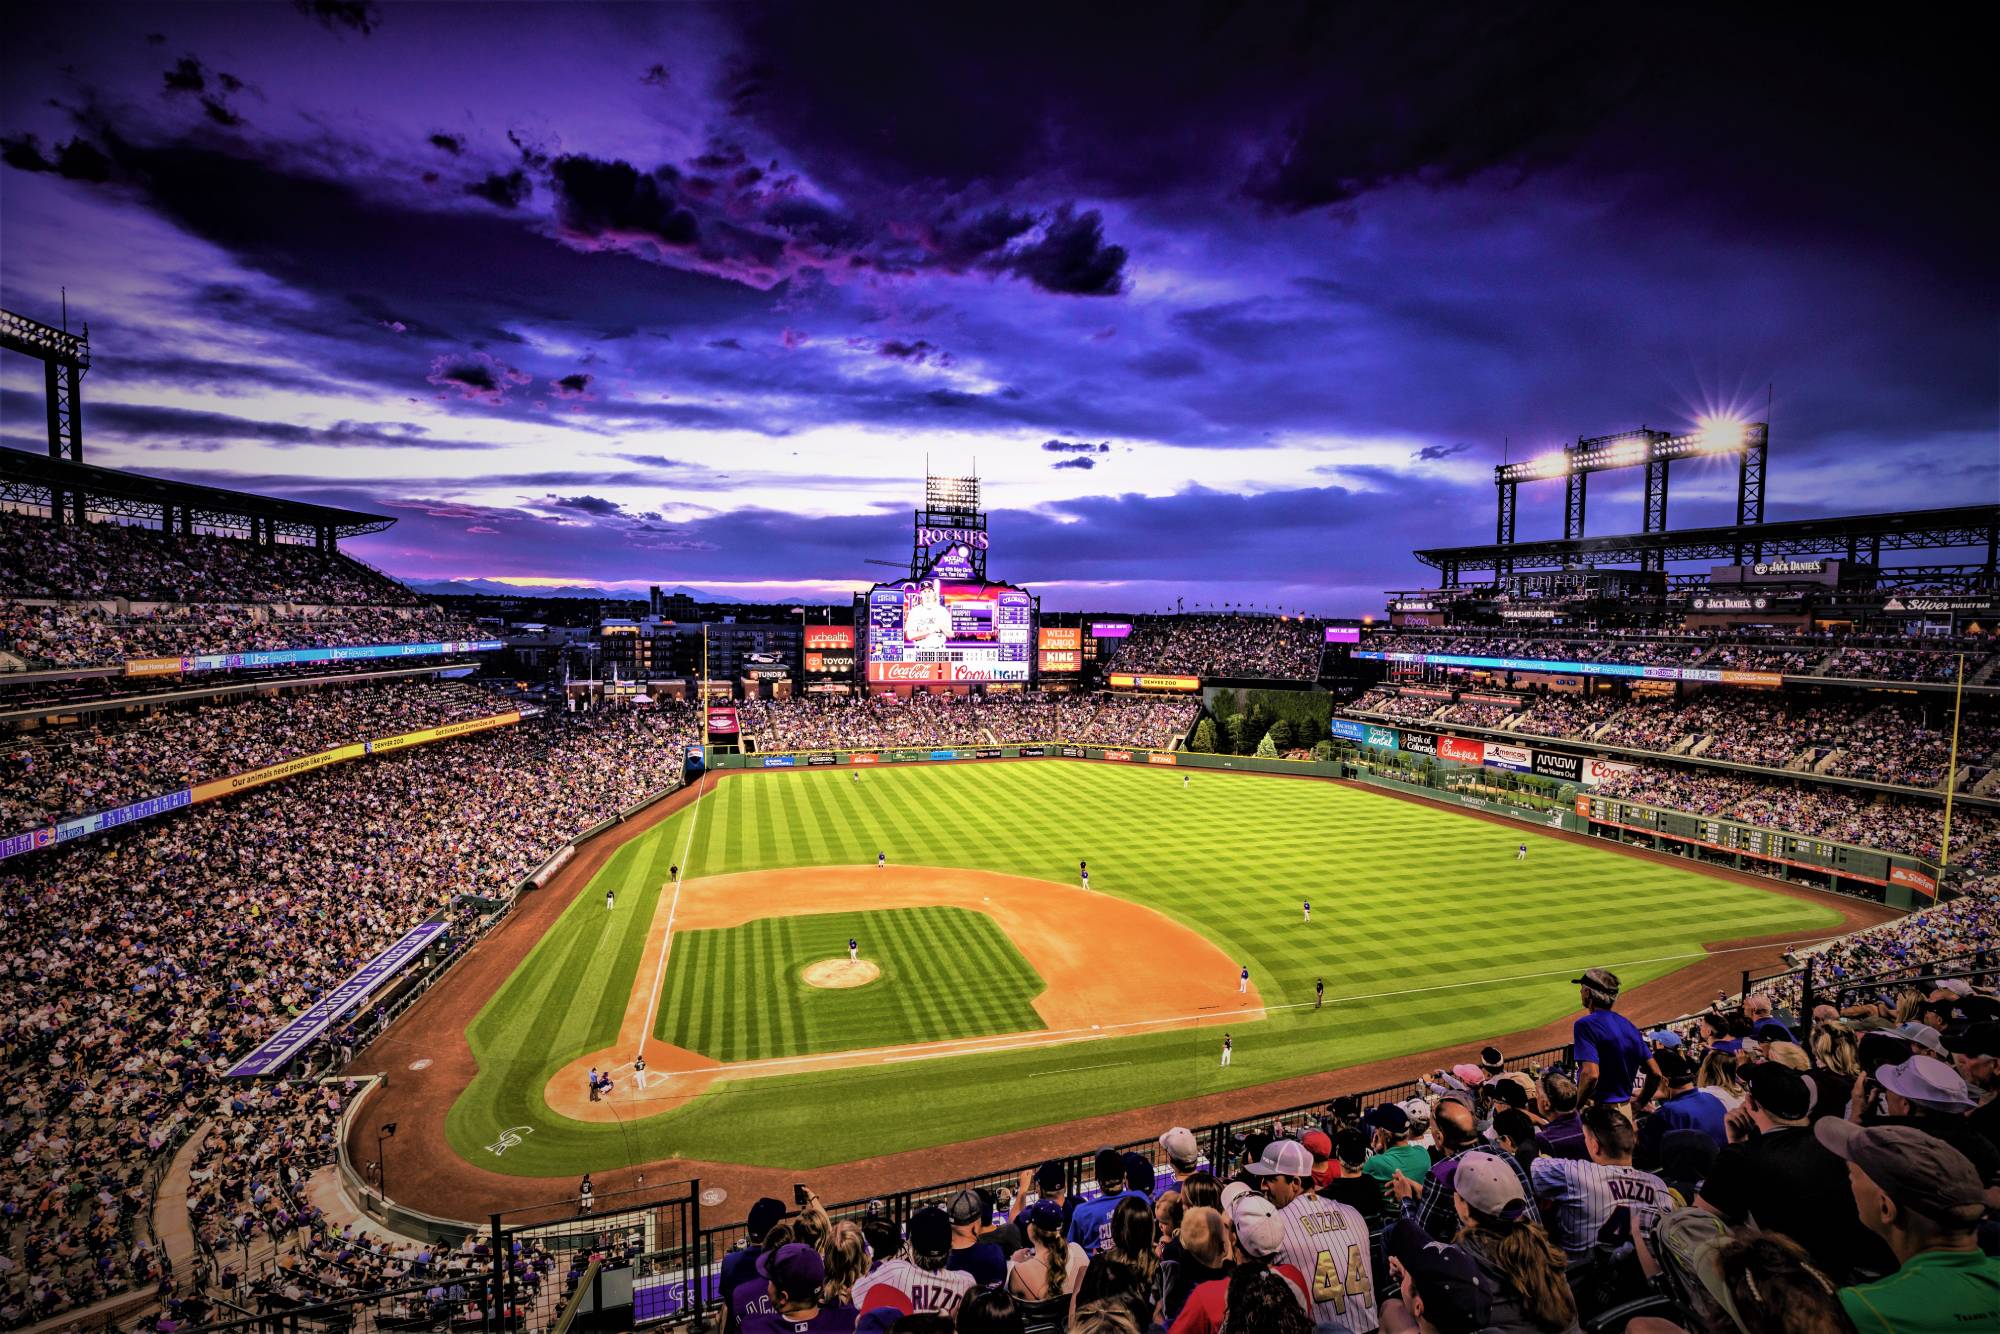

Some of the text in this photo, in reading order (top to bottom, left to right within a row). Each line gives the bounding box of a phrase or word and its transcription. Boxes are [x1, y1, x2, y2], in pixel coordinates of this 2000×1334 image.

[916, 528, 989, 550] ROCKIES
[1769, 560, 1821, 572] JACK DANIEL'S
[1707, 599, 1751, 608] JACK DANIEL'S
[1907, 600, 1950, 610] Silver
[1405, 614, 1430, 626] Coors
[1503, 610, 1554, 618] SMASHBURGER
[811, 632, 848, 641] uchealth
[329, 648, 376, 659] Uber Rewards
[402, 646, 416, 654] Uber
[251, 655, 269, 665] Uber
[1047, 652, 1074, 662] KING
[888, 664, 932, 679] Coca-Cola
[955, 664, 991, 680] Coors
[1581, 664, 1601, 672] Uber
[1602, 666, 1636, 676] Rewards
[1369, 727, 1392, 737] Comfort
[375, 738, 404, 749] DENVER ZOO
[1368, 735, 1393, 746] dental
[1407, 734, 1431, 744] Bank of
[1407, 741, 1436, 754] Colorado
[232, 755, 332, 787] Our animals need people like you.
[1549, 768, 1564, 777] Years
[1565, 771, 1575, 779] Out
[1591, 761, 1620, 779] Coo
[60, 826, 82, 841] DARVISH
[263, 934, 428, 1053] WELCOME TO COORS FIELD
[1608, 1180, 1654, 1205] RIZZO
[1300, 1211, 1347, 1237] RIZZO
[1312, 1243, 1372, 1316] 44
